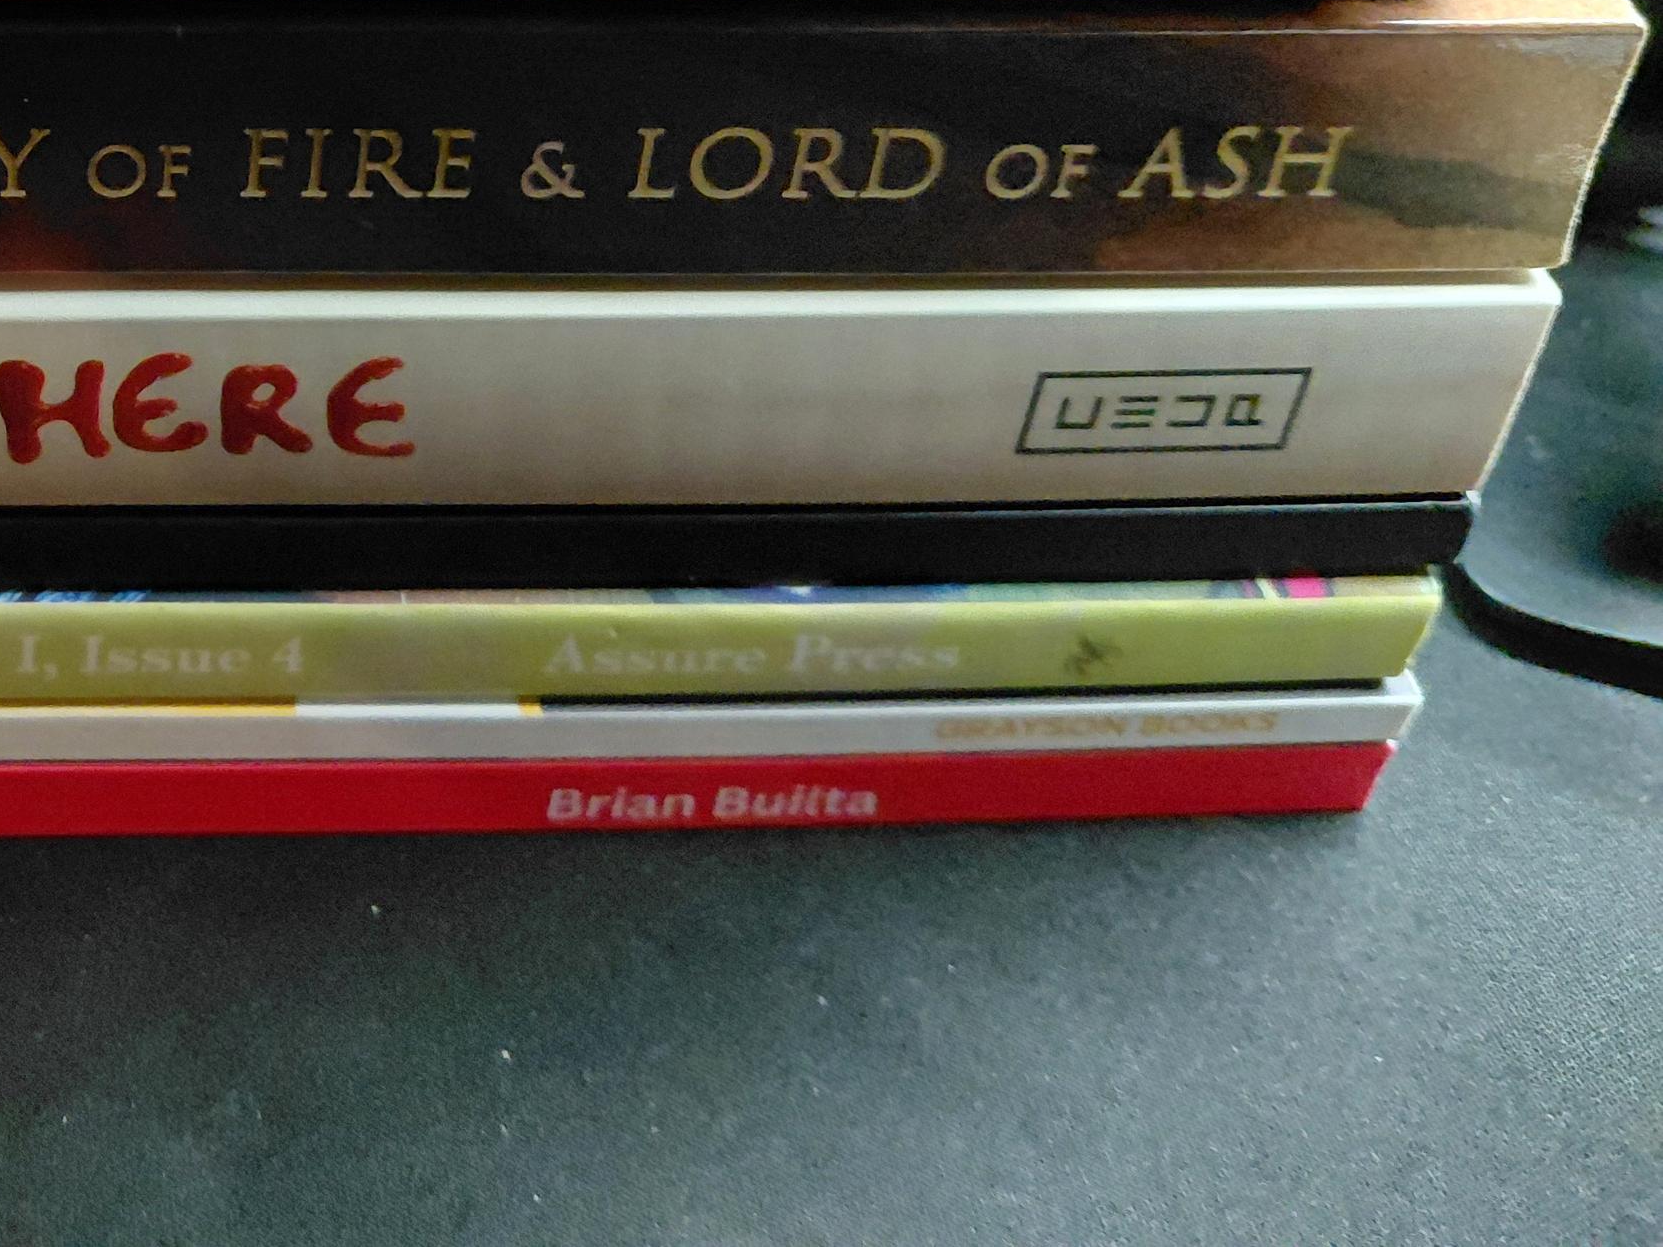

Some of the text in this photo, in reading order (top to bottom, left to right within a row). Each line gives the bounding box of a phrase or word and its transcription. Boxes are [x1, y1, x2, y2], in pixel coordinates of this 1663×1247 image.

[85, 144, 194, 200] OF
[238, 127, 477, 200] FIRE
[519, 140, 586, 201] &
[627, 125, 948, 202] LORD
[984, 143, 1100, 201] OF
[1116, 123, 1354, 202] ASH
[17, 634, 58, 680] I,
[79, 634, 250, 675] Issue
[270, 634, 306, 675] 4
[544, 633, 963, 677] Assure Press
[936, 711, 1279, 739] GRAYSON BOOKS
[546, 786, 698, 821] Brian
